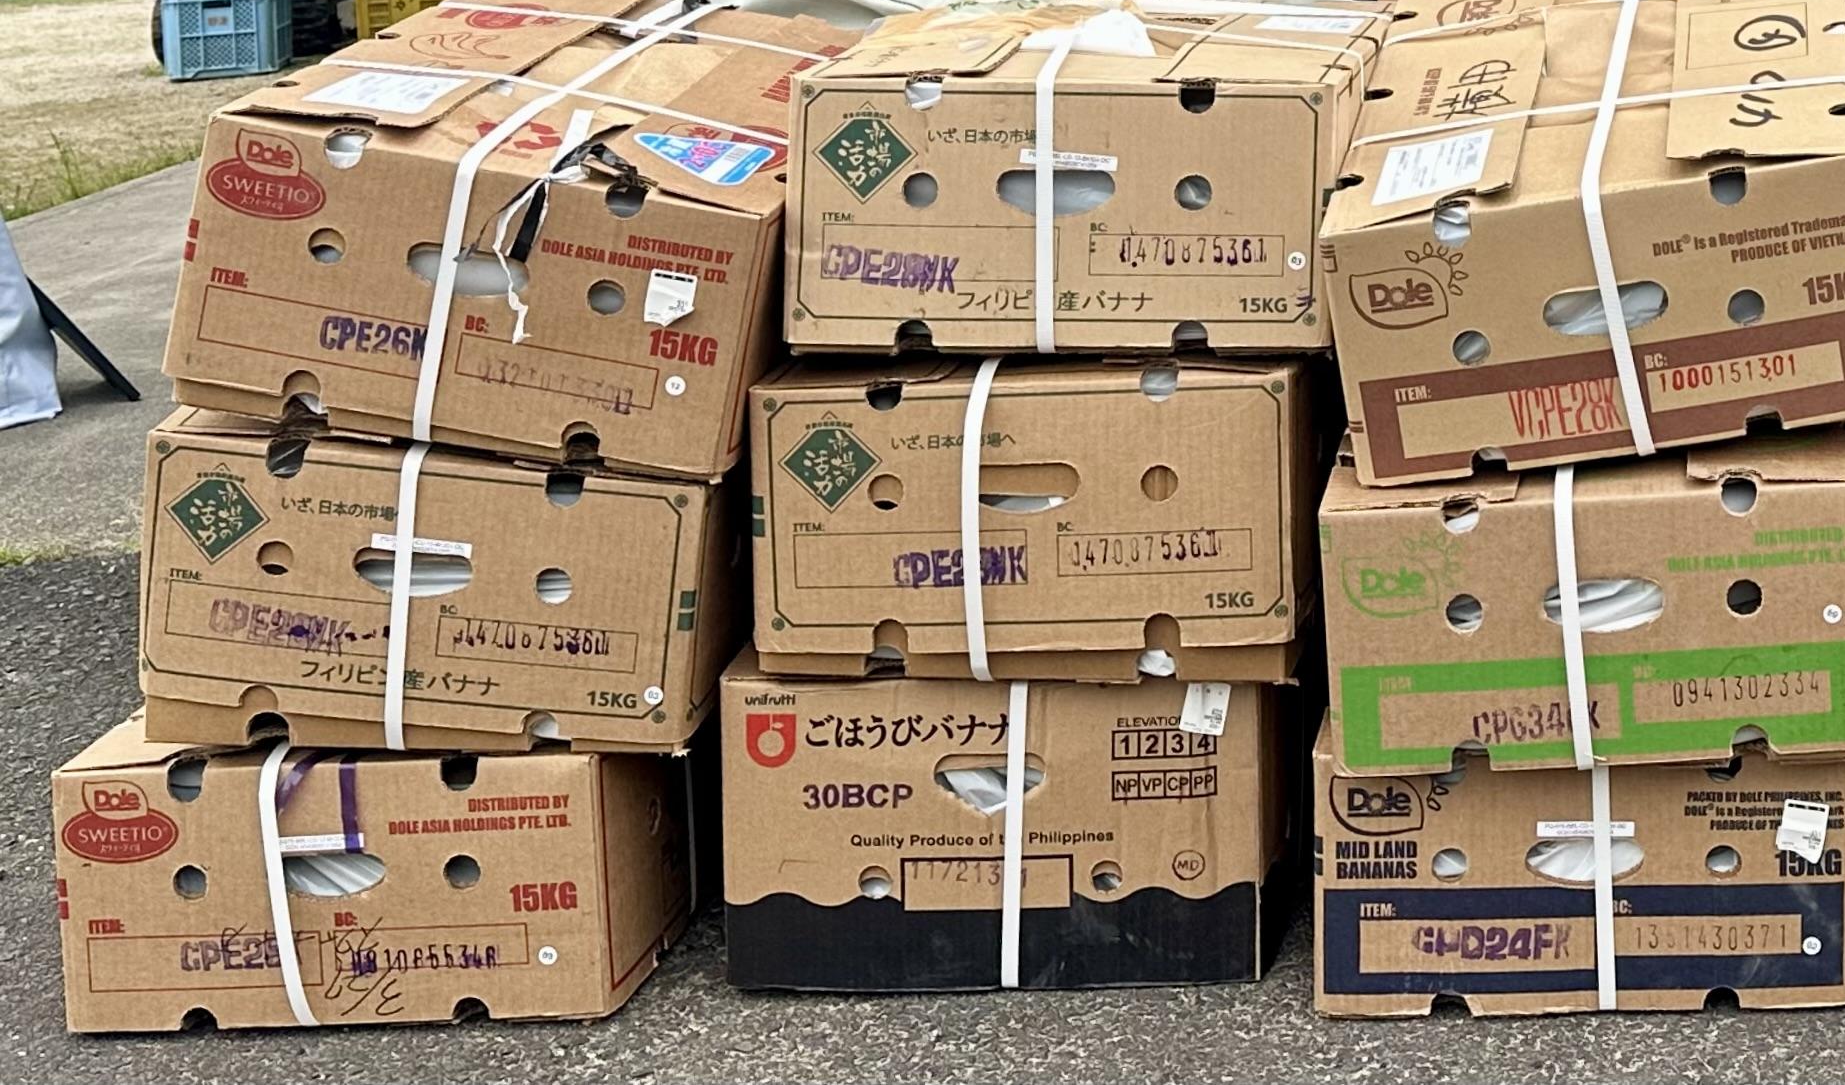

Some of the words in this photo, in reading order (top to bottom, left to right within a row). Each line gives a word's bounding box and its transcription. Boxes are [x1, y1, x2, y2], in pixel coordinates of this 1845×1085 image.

[246, 139, 295, 169] Dole
[222, 174, 312, 204] SWEETIO
[822, 212, 855, 222] ITEM:
[1709, 237, 1718, 248] a
[1718, 221, 1790, 247] Registered
[541, 239, 574, 258] DOLE
[574, 244, 605, 264] ASIA
[628, 235, 713, 262] DISTRIBUTED
[715, 251, 734, 265] BY
[1731, 239, 1790, 263] PRODUCE
[1790, 236, 1808, 254] OF
[210, 267, 248, 288] ITEM:
[957, 289, 1153, 312] フィリピ産バナナ
[1367, 278, 1434, 307] Dole
[1239, 297, 1288, 314] 15KG
[464, 315, 490, 334] BC:
[650, 329, 718, 366] 15KG
[1644, 351, 1668, 370] BC:
[1659, 354, 1797, 393] 1000151301
[1394, 385, 1432, 403] ITEM:
[793, 522, 826, 533] ITEM:
[1360, 566, 1427, 598] Dole
[1204, 591, 1254, 609] 15KG
[1672, 670, 1820, 708] 0941302334
[587, 690, 637, 710] 15KG
[745, 694, 796, 706] unifrutti
[804, 713, 1009, 749] ごほうびバナナ
[1119, 734, 1131, 756] 1
[1145, 734, 1160, 755] 2
[1171, 733, 1185, 754] 3
[1196, 733, 1211, 753] 4
[1115, 778, 1139, 794] NP
[1141, 777, 1163, 792] VP
[1166, 776, 1190, 792] CP
[1193, 773, 1214, 790] PP
[93, 788, 141, 812] Dole
[468, 797, 549, 813] DISTRIBUTED
[551, 795, 570, 810] BY
[803, 783, 914, 809] 30BCP
[1347, 787, 1412, 814] Dole
[78, 825, 164, 844] SWEETIO
[388, 820, 420, 835] DOLE
[421, 819, 450, 834] ASIA
[452, 816, 516, 833] HOLDINGS
[517, 815, 544, 829] PTE.
[546, 814, 572, 828] LTD.
[850, 834, 904, 848] Quality
[909, 834, 974, 846] Produce
[979, 833, 994, 846] of
[1028, 831, 1115, 845] Philippines
[1335, 841, 1370, 859] MID
[1374, 840, 1418, 859] LAND
[1336, 861, 1418, 880] BANANAS
[509, 881, 578, 912] 15KG
[1360, 902, 1397, 918] ITEM:
[88, 919, 125, 935] ITEM:
